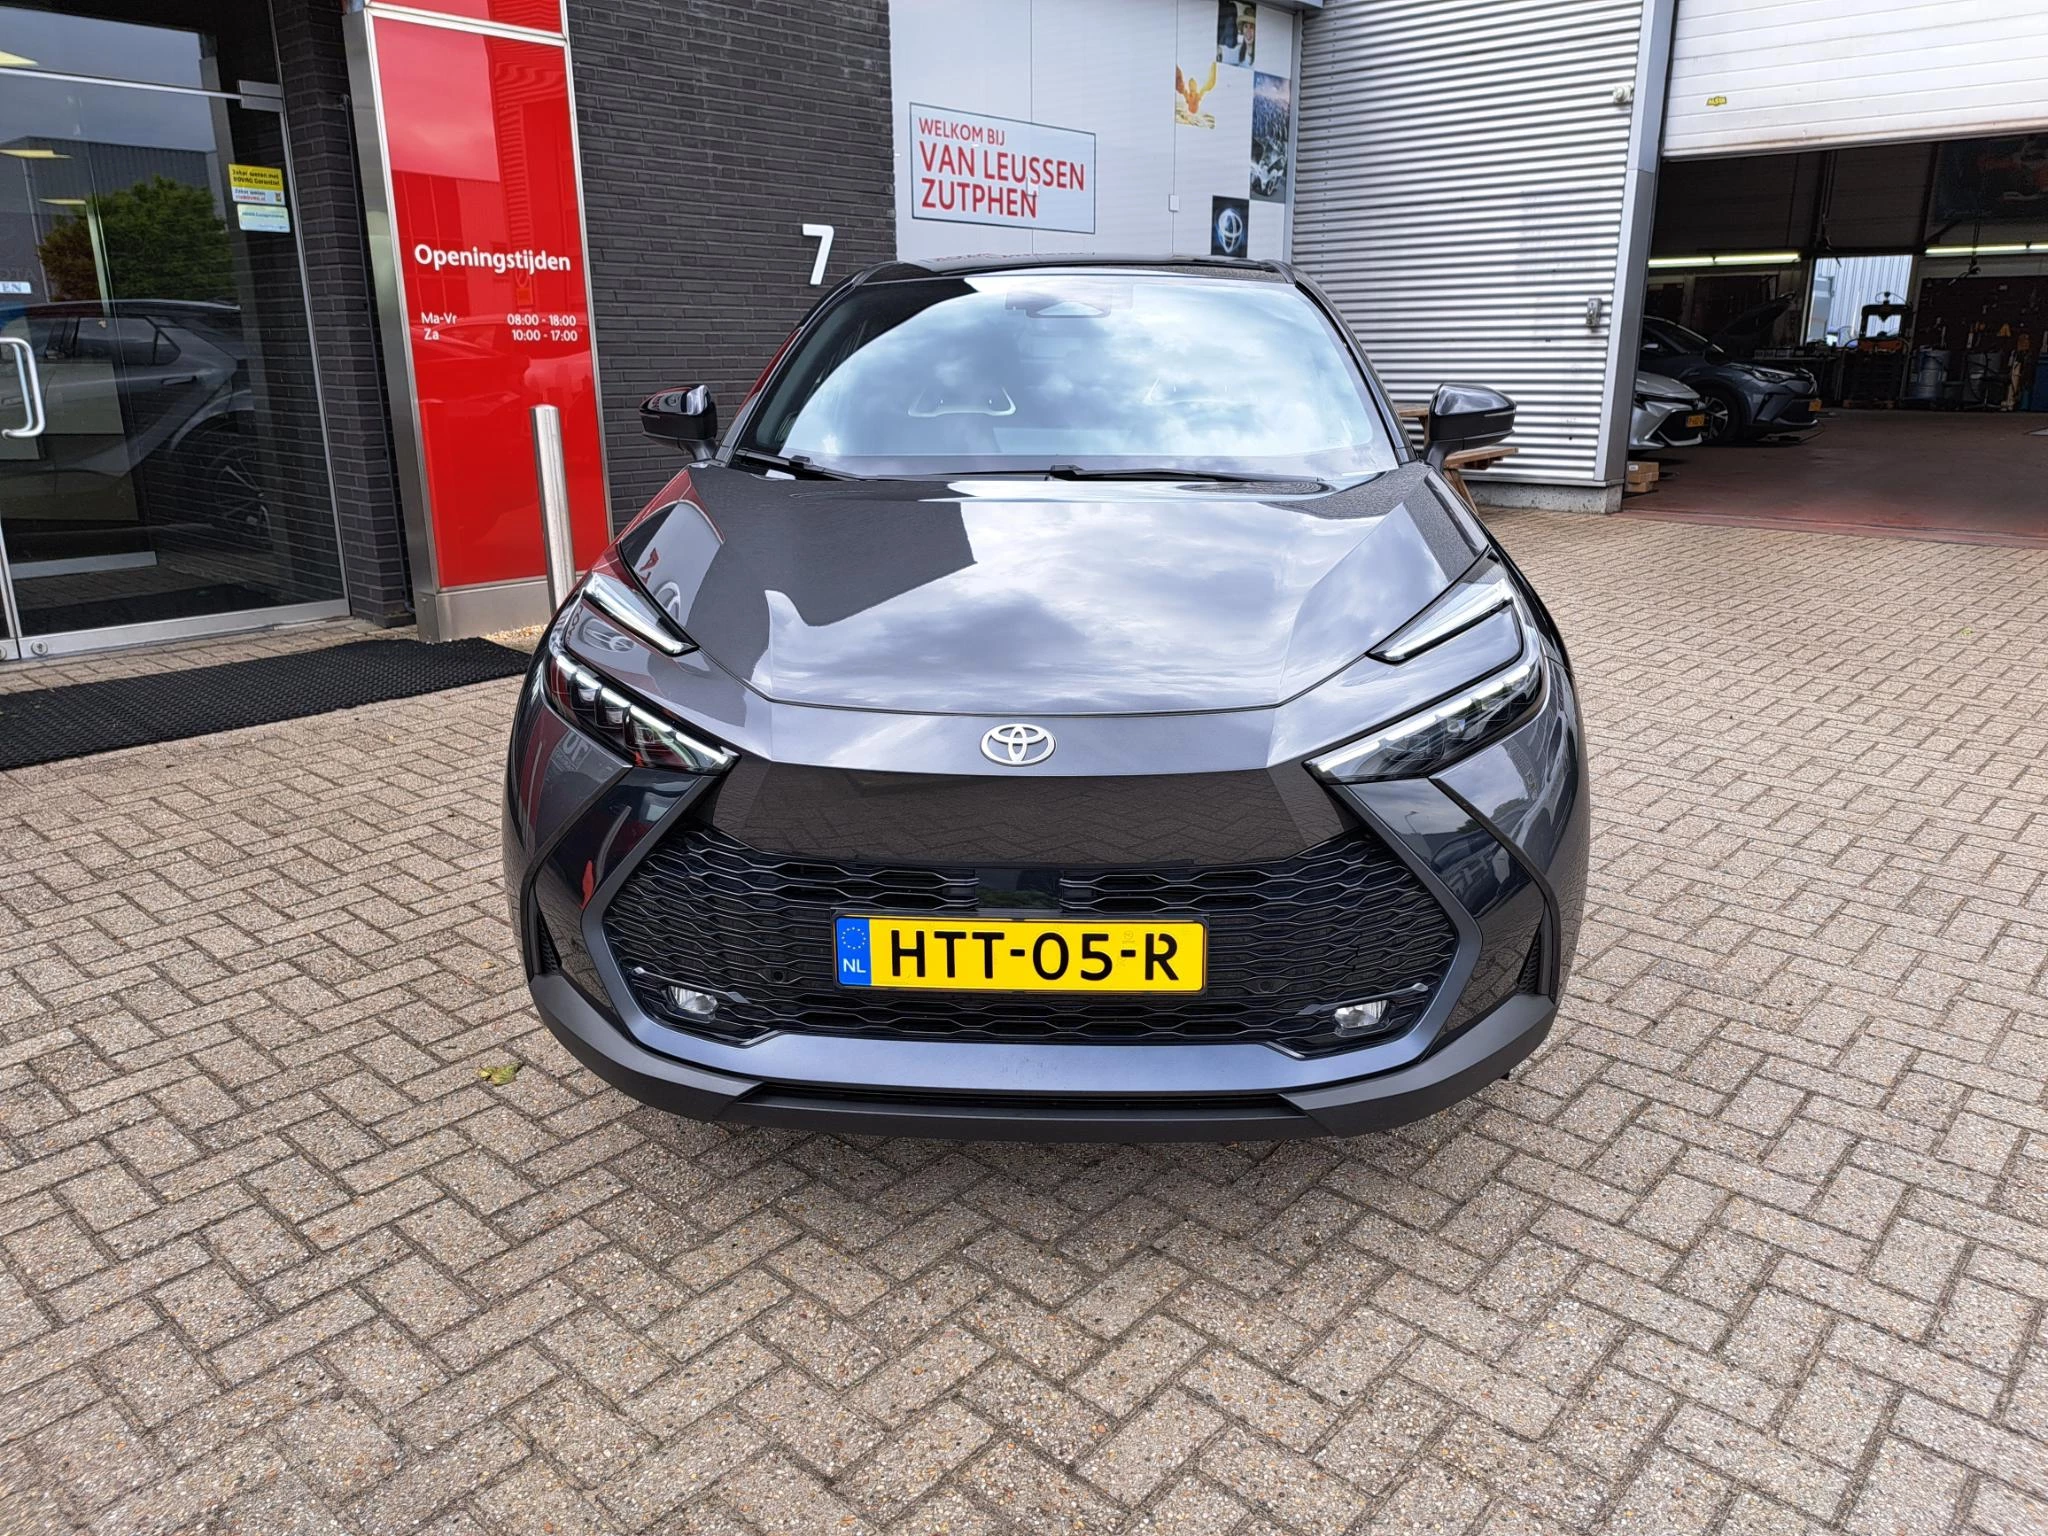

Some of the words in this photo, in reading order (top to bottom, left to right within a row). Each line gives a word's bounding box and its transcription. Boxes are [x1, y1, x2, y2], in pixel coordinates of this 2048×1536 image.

[918, 117, 983, 143] WELKOM
[987, 128, 1005, 146] BIJ
[919, 141, 975, 177] VAN
[984, 150, 1084, 191] LEUSSEN
[921, 177, 1037, 218] ZUTPHEN
[414, 243, 571, 275] Openingstijden
[802, 224, 834, 285] 7
[421, 312, 457, 325] Ma-Vr
[507, 313, 539, 326] 08:00
[549, 314, 577, 327] 18:00
[424, 328, 440, 341] Za
[512, 329, 541, 341] 10:00
[551, 330, 578, 342] 17:00
[843, 958, 866, 973] NL
[891, 930, 1180, 981] HTT-05-R
